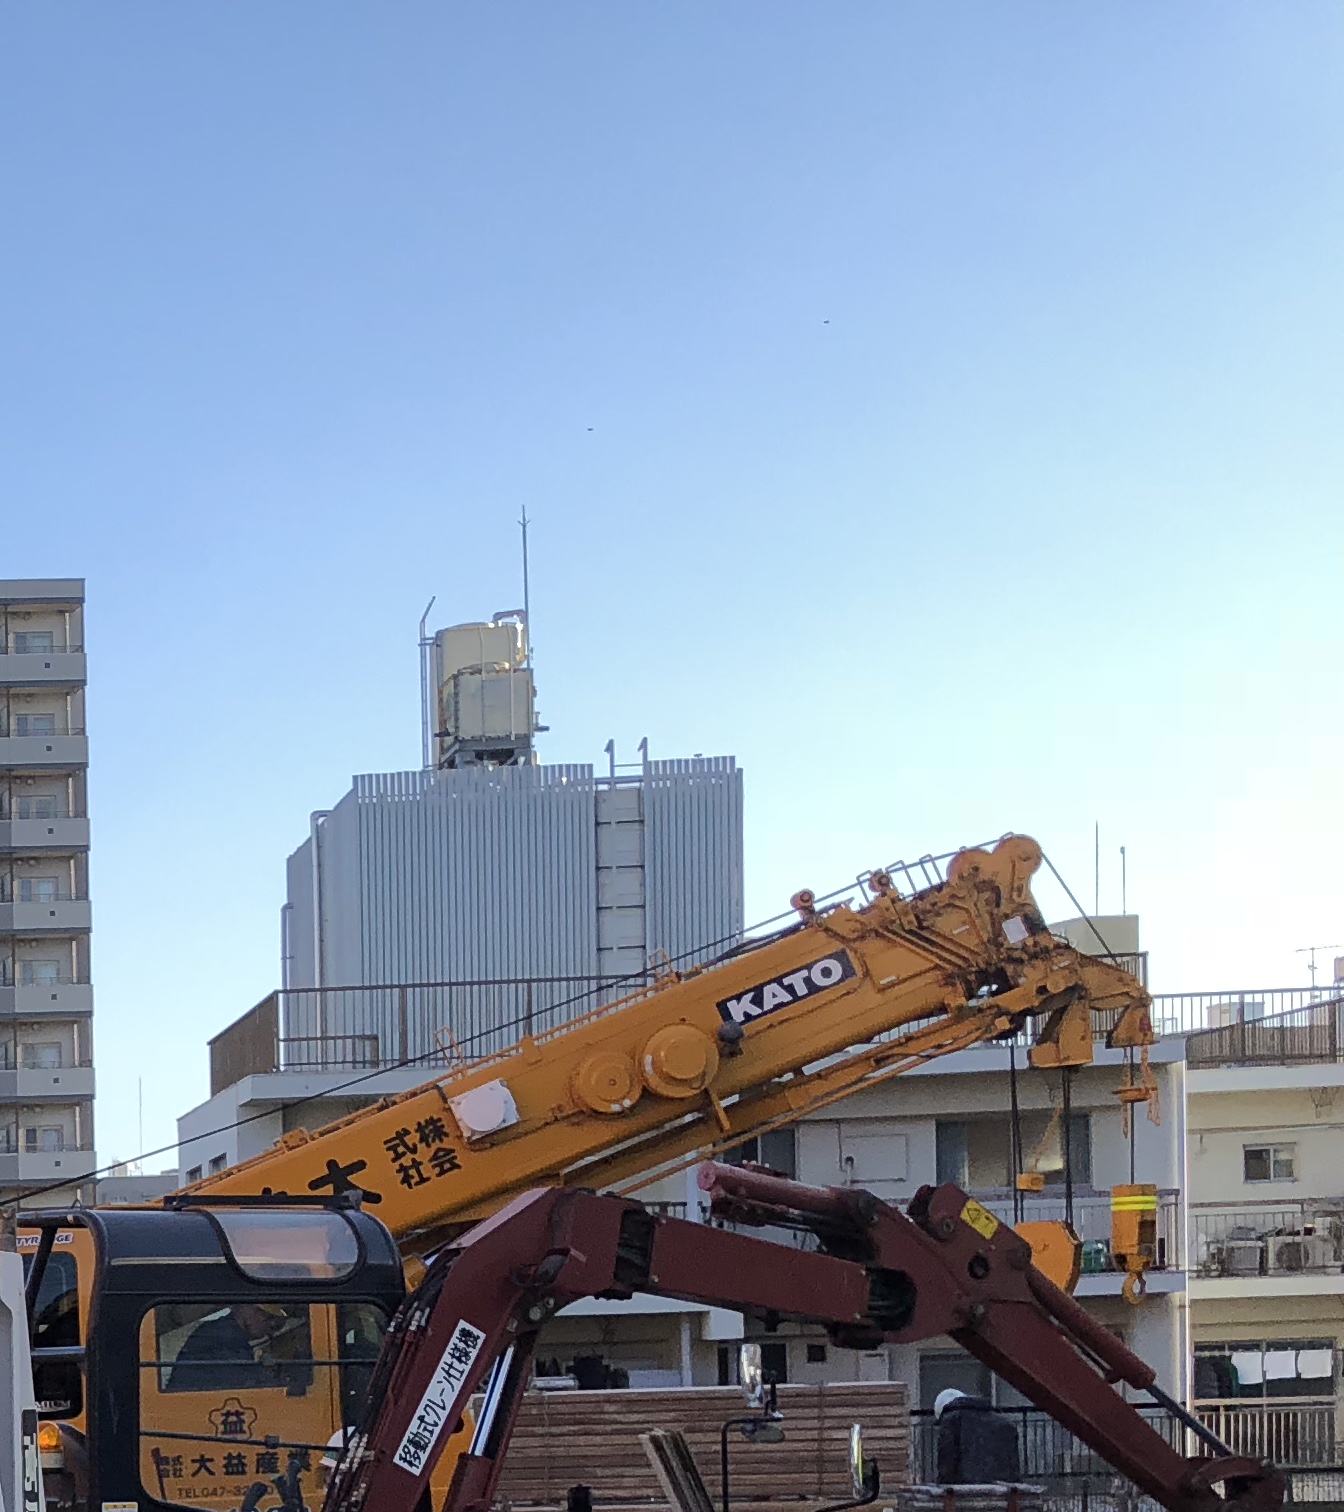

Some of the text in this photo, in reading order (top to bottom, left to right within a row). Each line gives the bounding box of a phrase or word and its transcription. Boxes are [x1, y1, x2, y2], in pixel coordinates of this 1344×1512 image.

[725, 957, 844, 1023] KATO
[398, 1326, 481, 1470] 移動式クレーン仕様機
